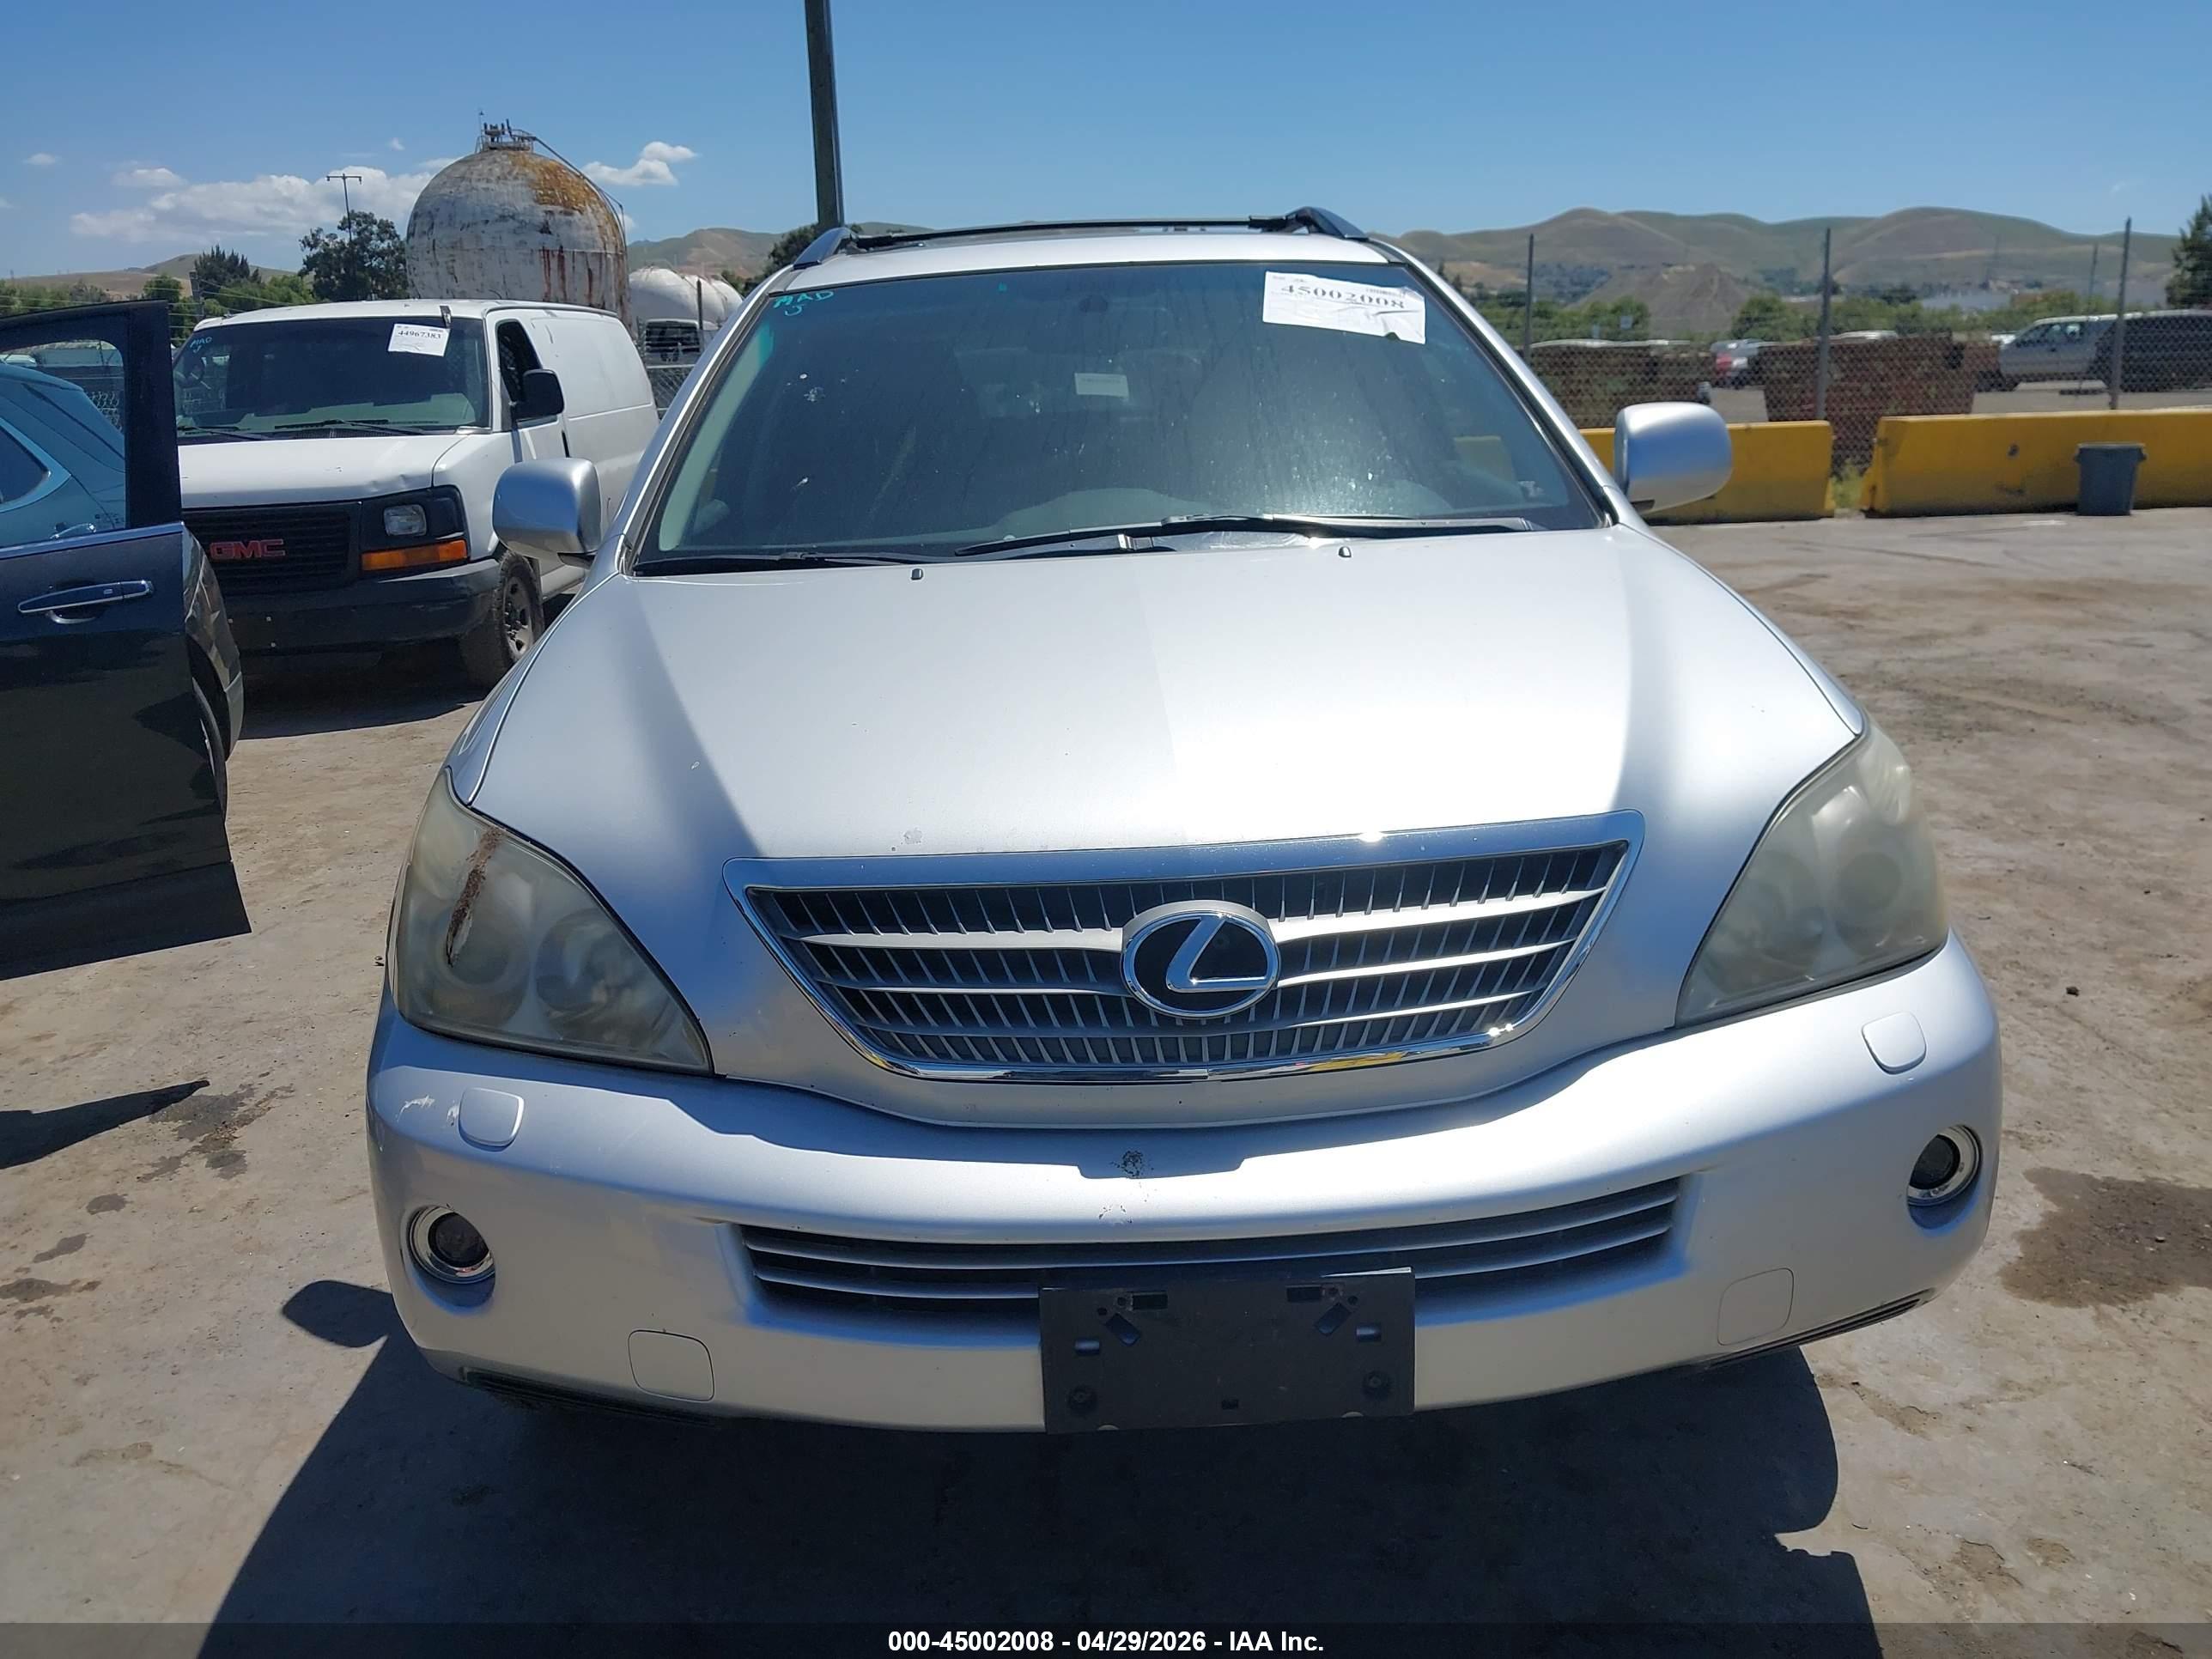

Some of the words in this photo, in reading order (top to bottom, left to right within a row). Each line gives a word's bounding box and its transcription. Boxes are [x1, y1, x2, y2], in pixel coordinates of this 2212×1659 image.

[1281, 285, 1405, 308] 45002008
[398, 330, 441, 339] 44967383
[210, 538, 286, 559] GMC
